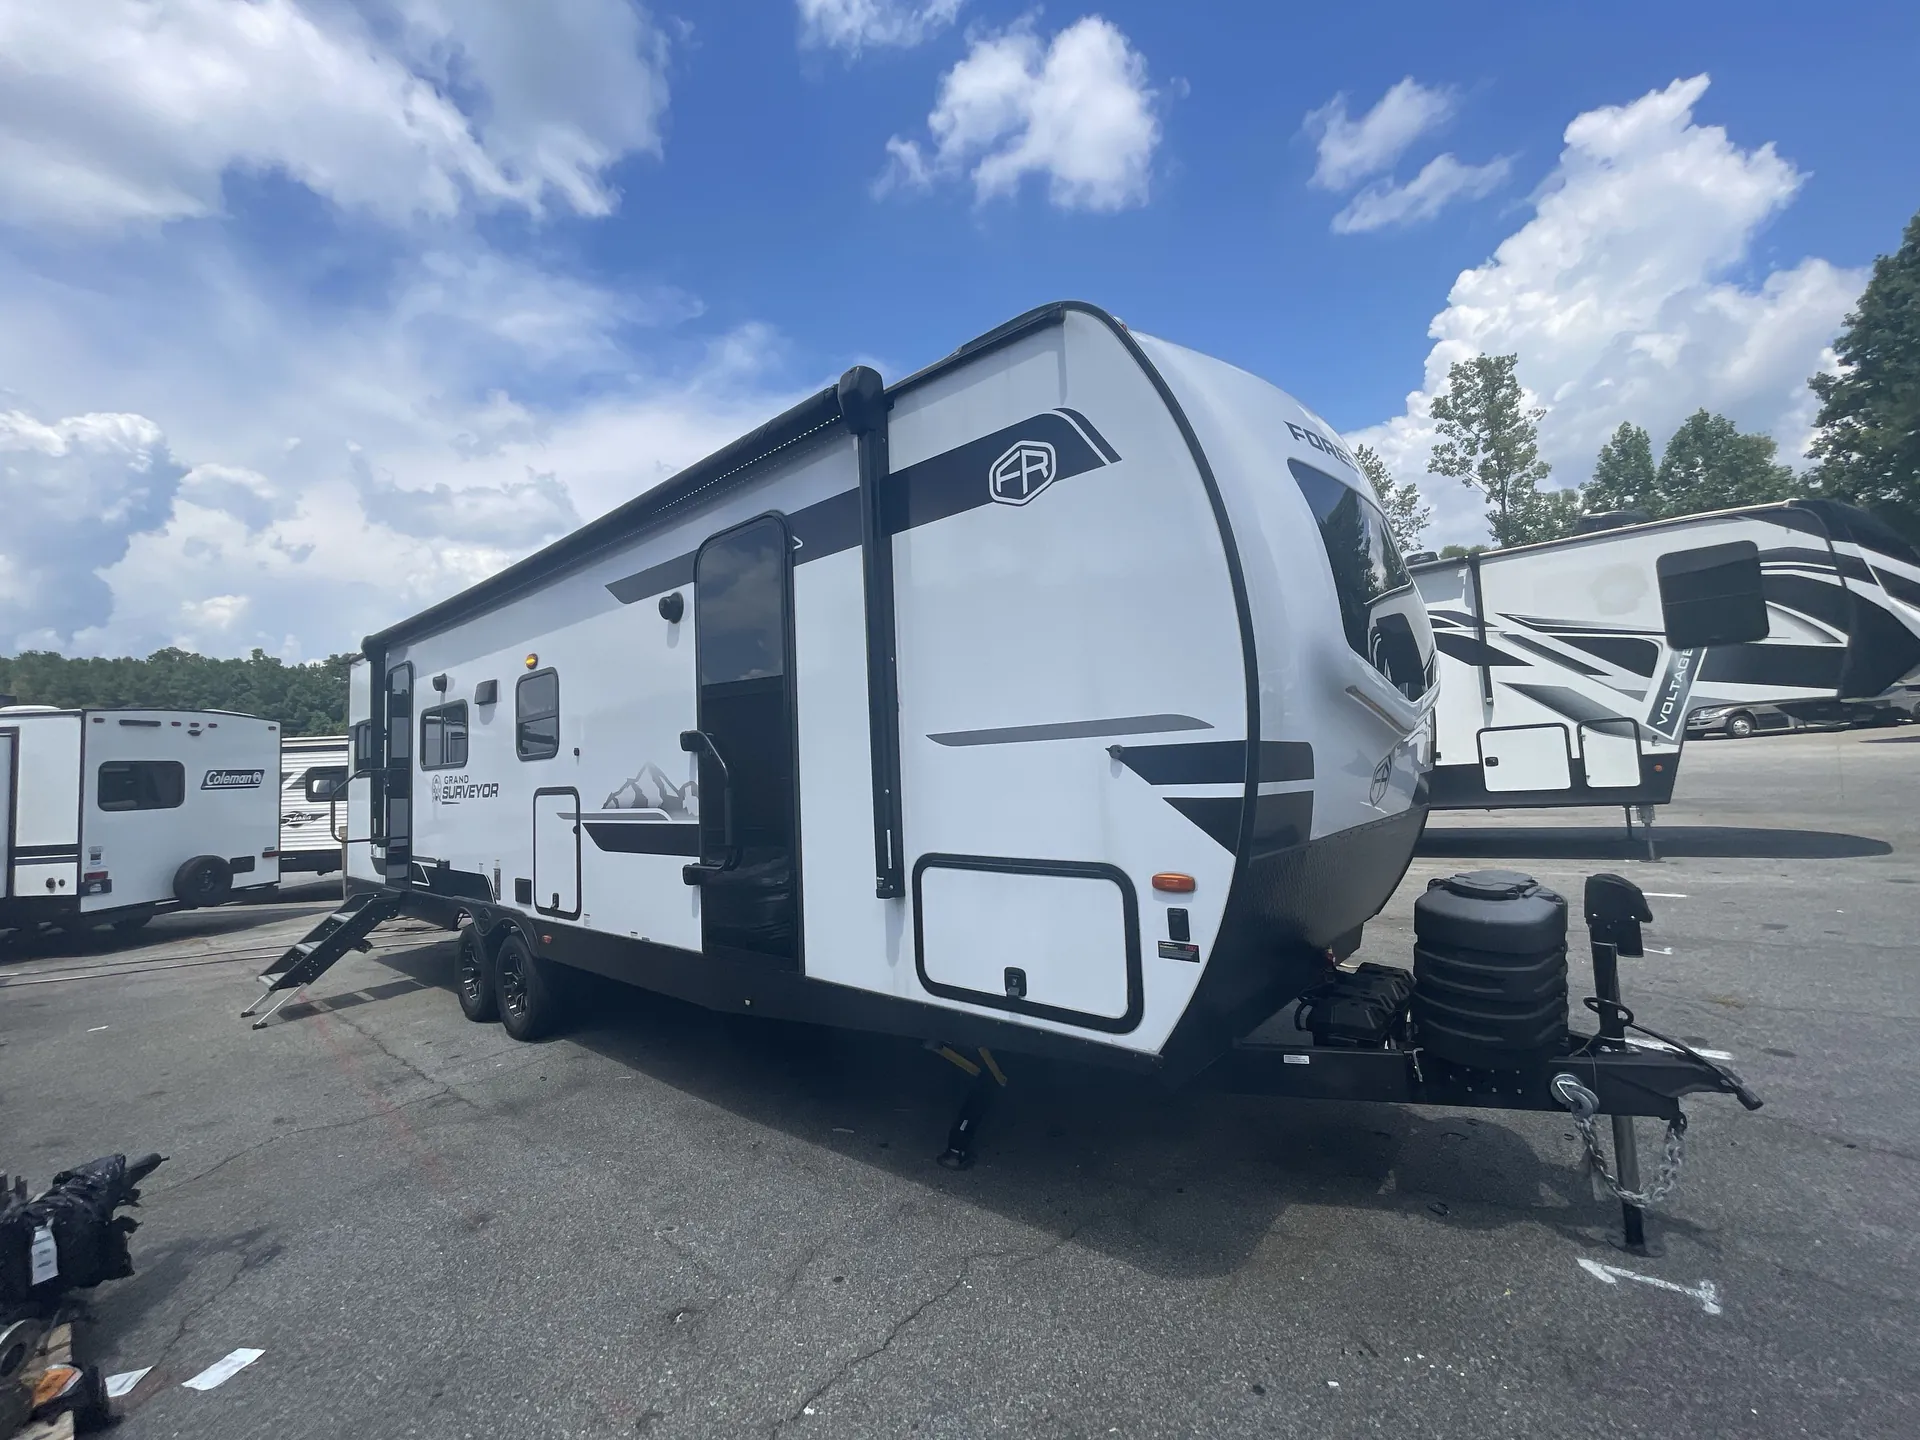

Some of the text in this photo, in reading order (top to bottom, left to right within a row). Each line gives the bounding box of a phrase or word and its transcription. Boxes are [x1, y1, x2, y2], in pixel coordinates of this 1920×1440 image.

[1656, 647, 1693, 725] VOLTAGE
[206, 771, 252, 785] Coleman
[444, 775, 469, 784] GRAND
[442, 783, 499, 799] SURVEYOR
